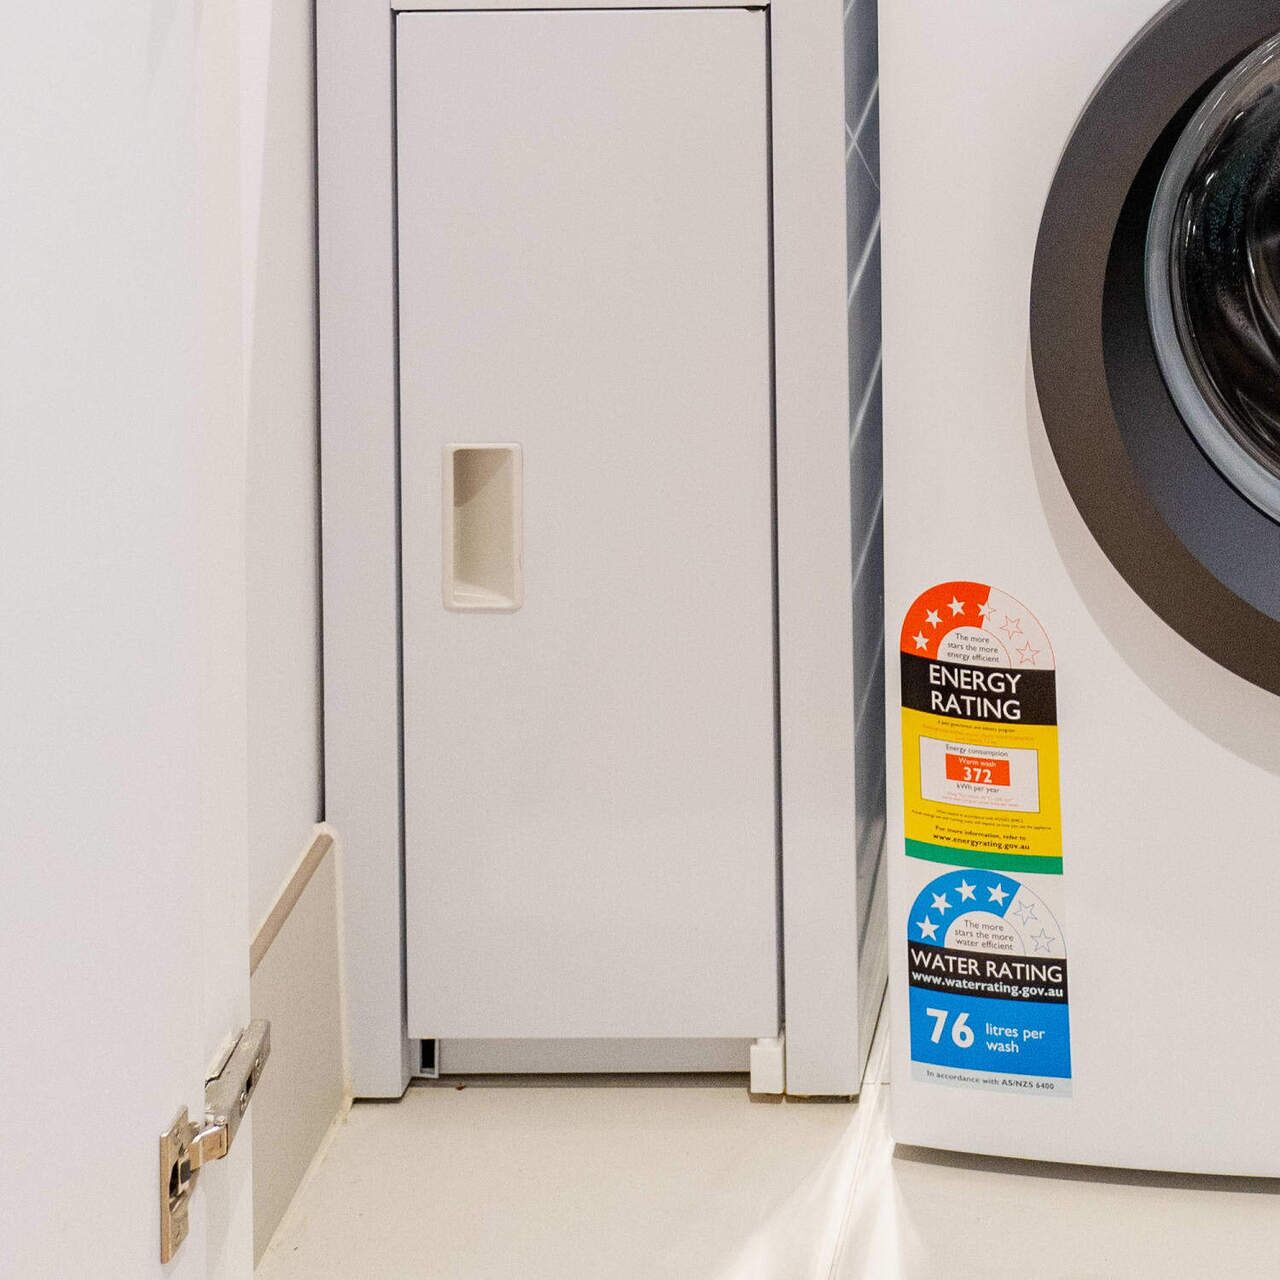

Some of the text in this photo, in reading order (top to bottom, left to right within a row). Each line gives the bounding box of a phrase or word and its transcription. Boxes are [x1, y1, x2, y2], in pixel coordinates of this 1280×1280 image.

[955, 632, 990, 644] The more
[947, 642, 999, 654] stars the more
[947, 651, 1000, 663] energy efficient
[929, 663, 1022, 694] ENERGY
[931, 690, 1021, 721] RATING
[945, 744, 1009, 758] Energy consumption
[958, 757, 997, 768] Warm wash
[963, 766, 993, 784] 372
[956, 783, 1000, 794] kWh per year
[964, 919, 1004, 932] The more
[954, 928, 1014, 942] stars the more
[956, 938, 1013, 951] water efficient
[910, 948, 1064, 983] WATER RATING
[911, 970, 1064, 998] www.waterrating.gov.au
[926, 1008, 975, 1049] 76
[985, 1022, 1046, 1041] litres per
[986, 1040, 1019, 1054] wash
[926, 1070, 935, 1078] In
[936, 1071, 980, 1085] accordance
[982, 1076, 1000, 1086] with
[1035, 1081, 1055, 1090] 6400
